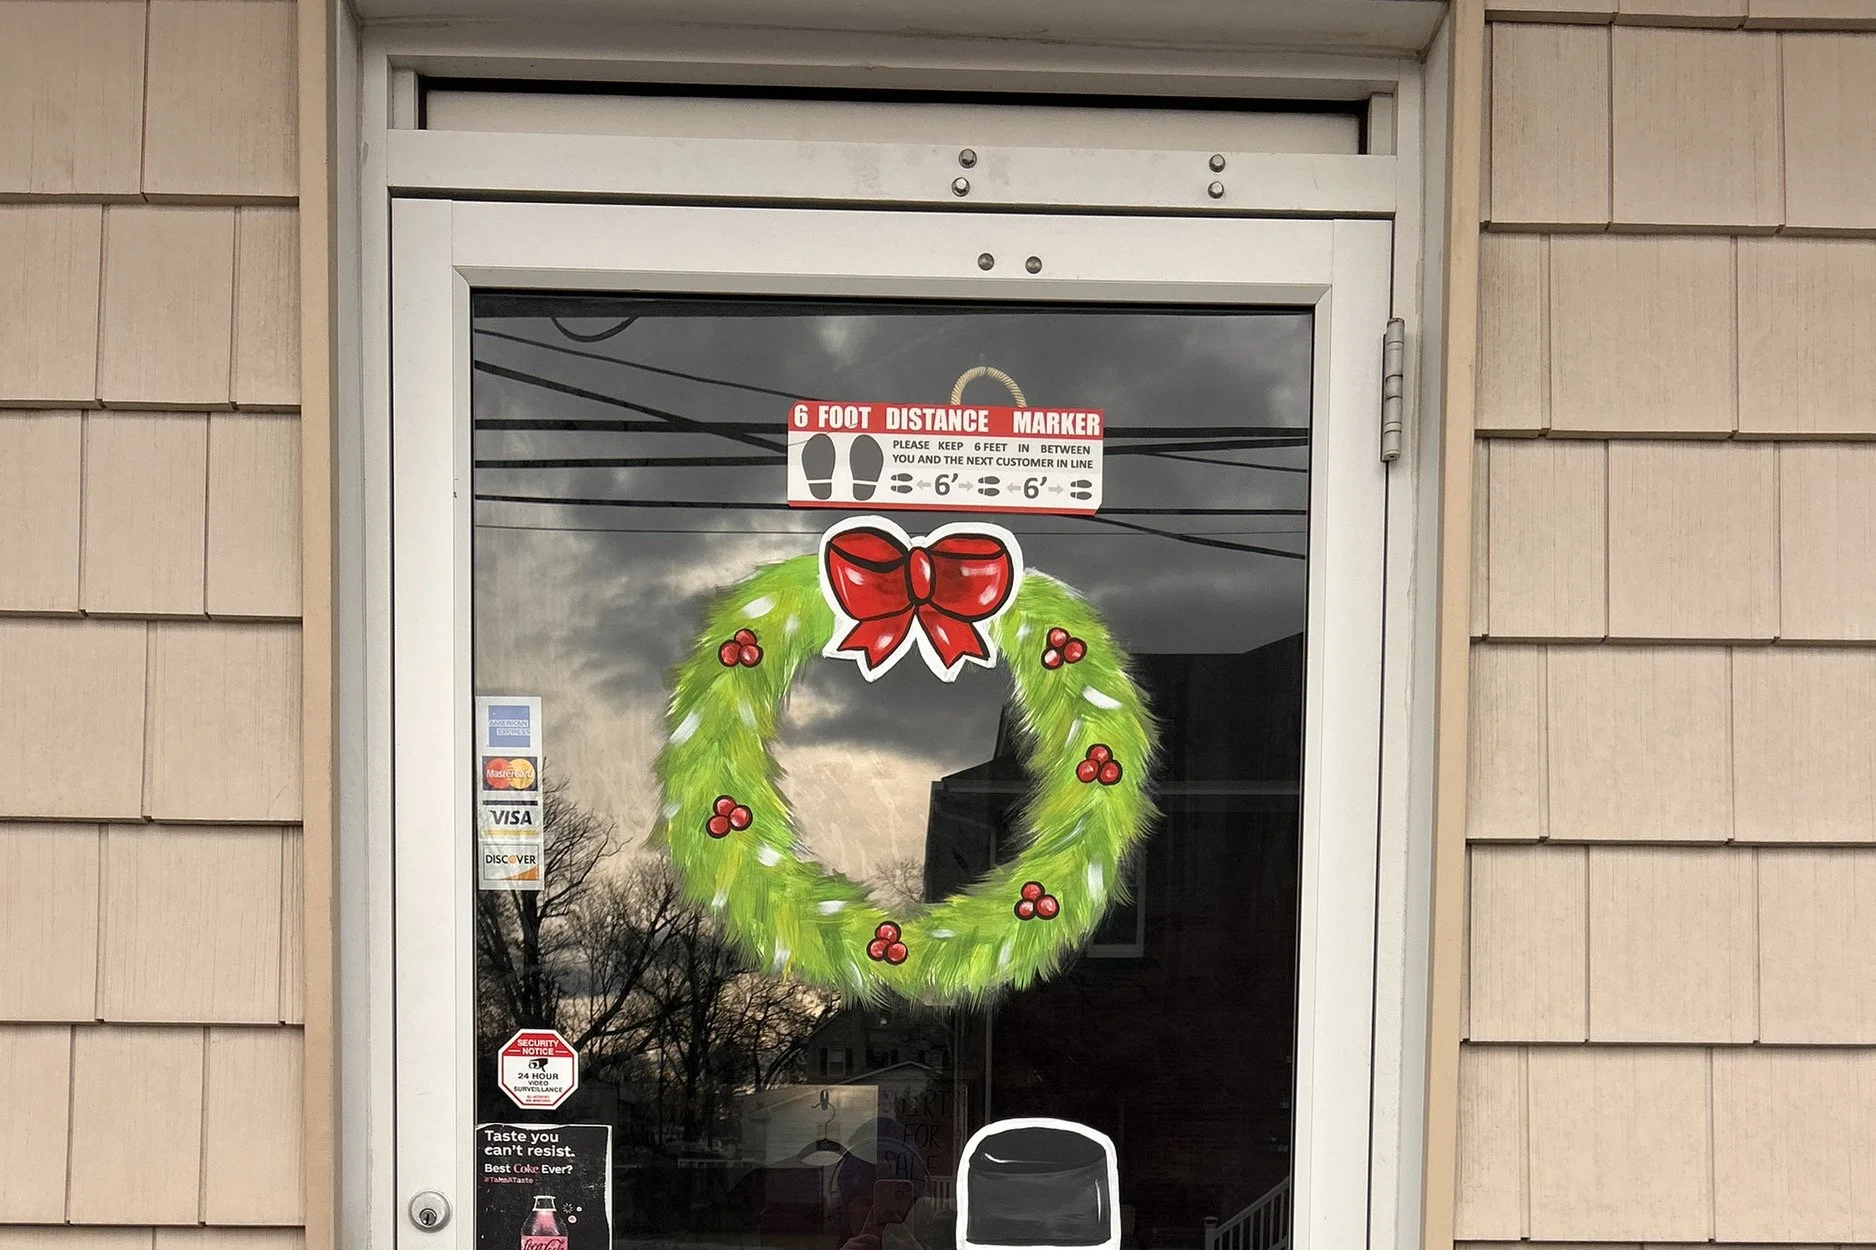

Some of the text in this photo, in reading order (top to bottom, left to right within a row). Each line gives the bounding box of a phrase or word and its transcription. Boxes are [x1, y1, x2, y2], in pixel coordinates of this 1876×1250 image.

[794, 405, 1100, 436] 6 FOOT DISTANCE MARKER
[893, 440, 1091, 455] PLEASE KEEP 6 FEET IN BETWEEN
[892, 454, 1093, 469] YOU AND THE NEXT CUSTOMER IN LINE
[489, 720, 528, 728] AMERICAN
[496, 728, 531, 736] EXPRESS
[490, 810, 533, 825] VISA
[486, 855, 536, 864] DISCOVER
[517, 1039, 559, 1047] SECURITY
[484, 1130, 559, 1144] Taste you
[903, 1124, 941, 1149] FOR
[484, 1145, 576, 1157] can't resist.
[484, 1163, 573, 1174] Best Coke Ever?
